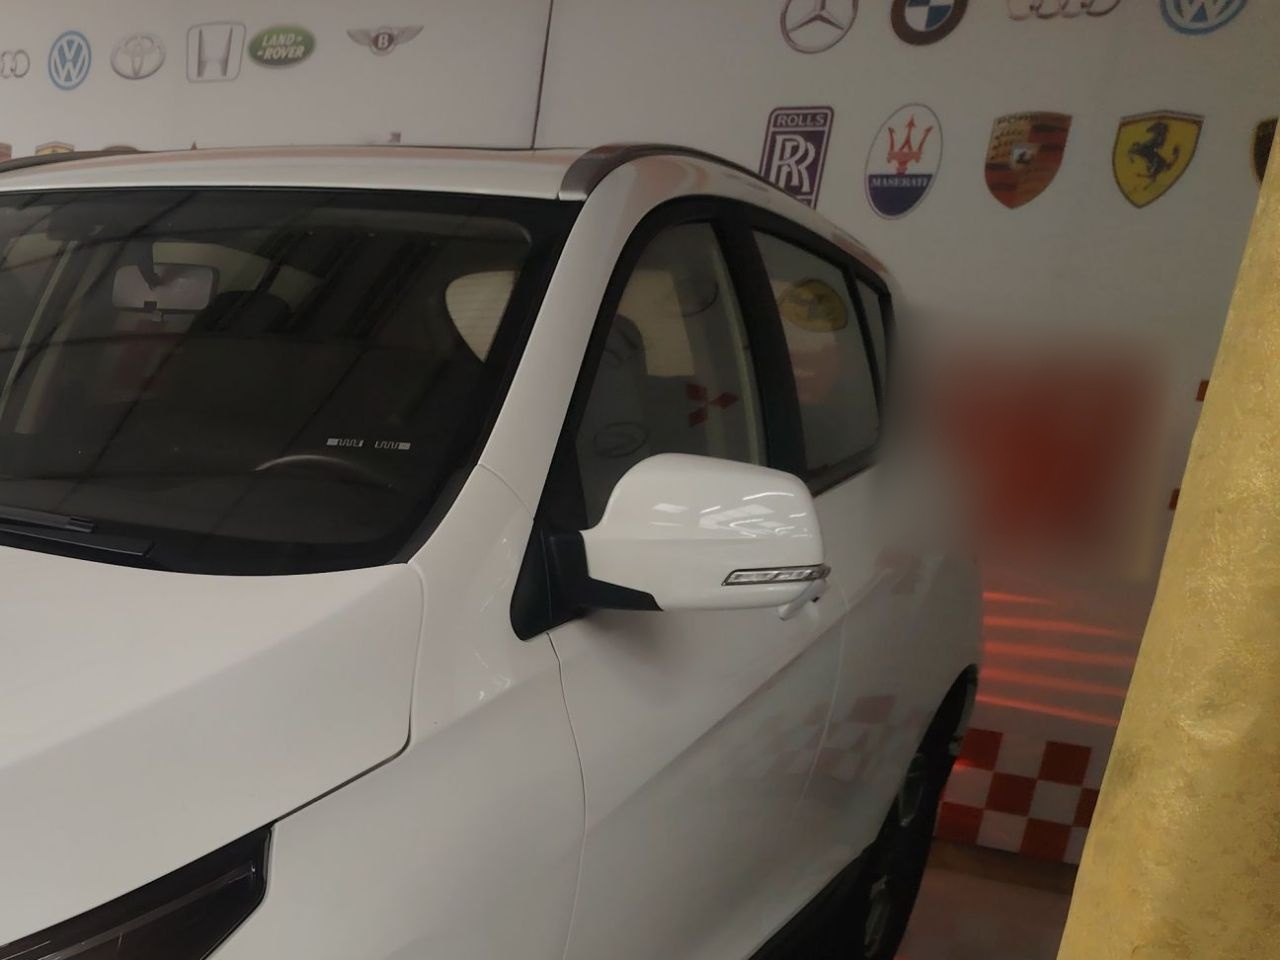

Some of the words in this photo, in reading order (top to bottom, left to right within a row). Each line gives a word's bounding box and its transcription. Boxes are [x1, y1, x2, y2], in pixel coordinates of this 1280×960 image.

[262, 34, 295, 46] LAND
[263, 45, 305, 60] ROVER
[776, 114, 825, 127] ROLLS
[872, 177, 929, 188] MASERATI
